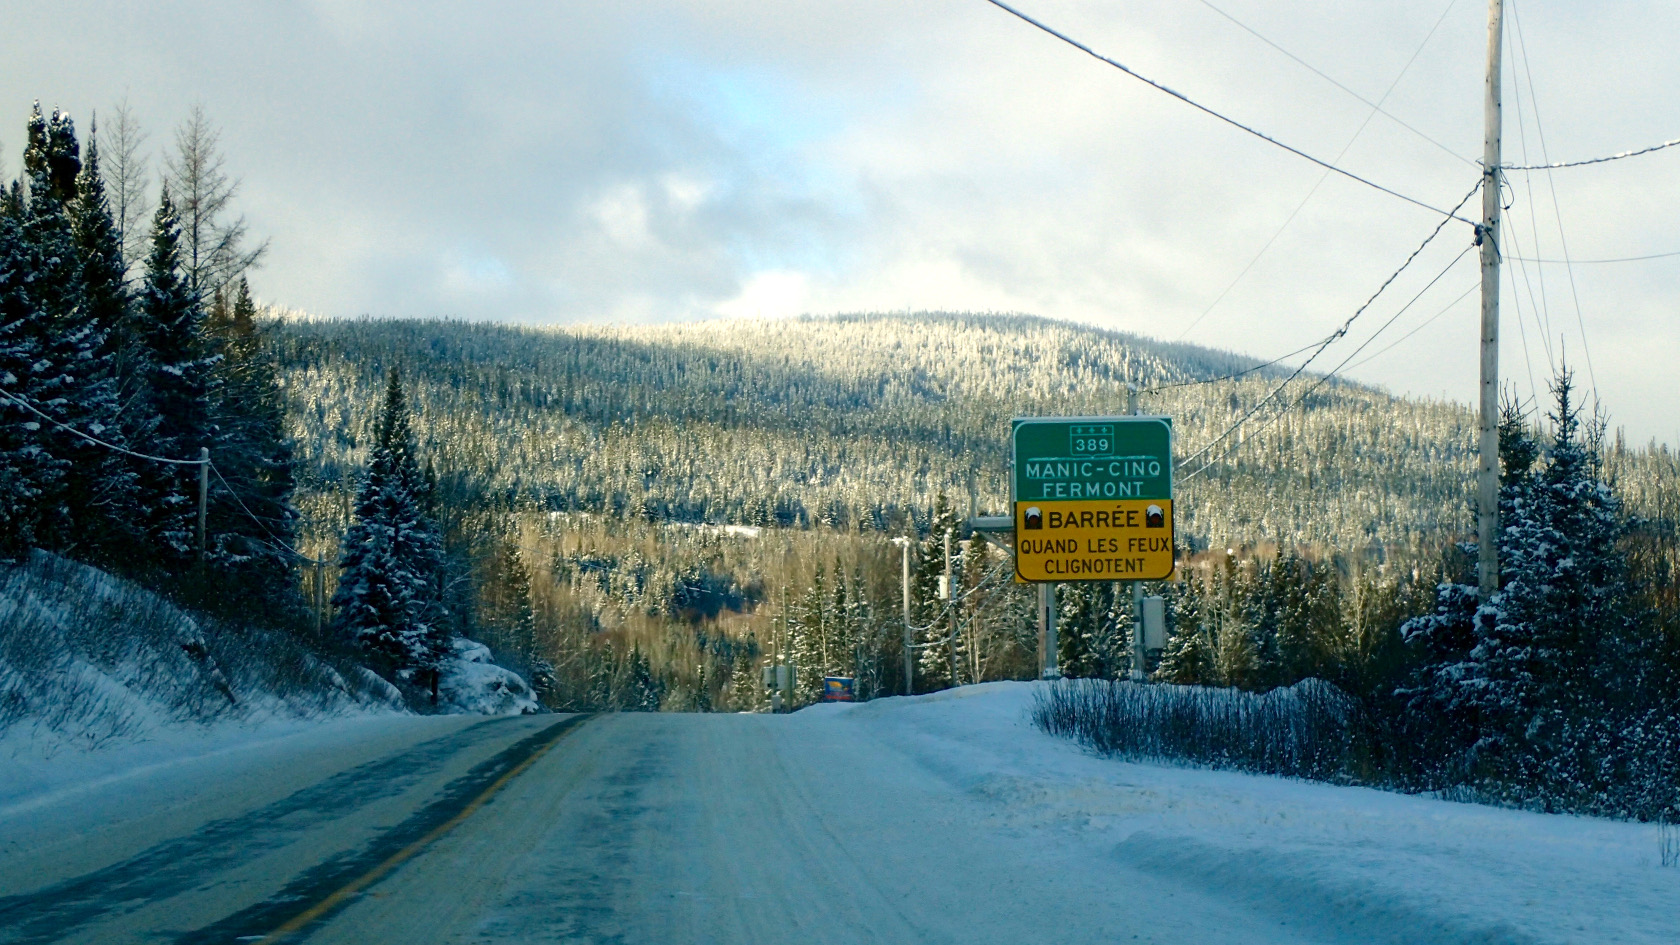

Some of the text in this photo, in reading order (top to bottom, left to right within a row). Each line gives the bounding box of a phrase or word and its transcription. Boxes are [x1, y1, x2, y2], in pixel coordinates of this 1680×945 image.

[1076, 439, 1108, 451] 389
[1026, 461, 1161, 478] MANIC-CINQ
[1043, 481, 1144, 498] FERMONT
[1049, 505, 1139, 528] BARRÉE
[1021, 537, 1170, 554] QUAND LES FEUX
[1044, 558, 1145, 574] CLIGNOTENT
